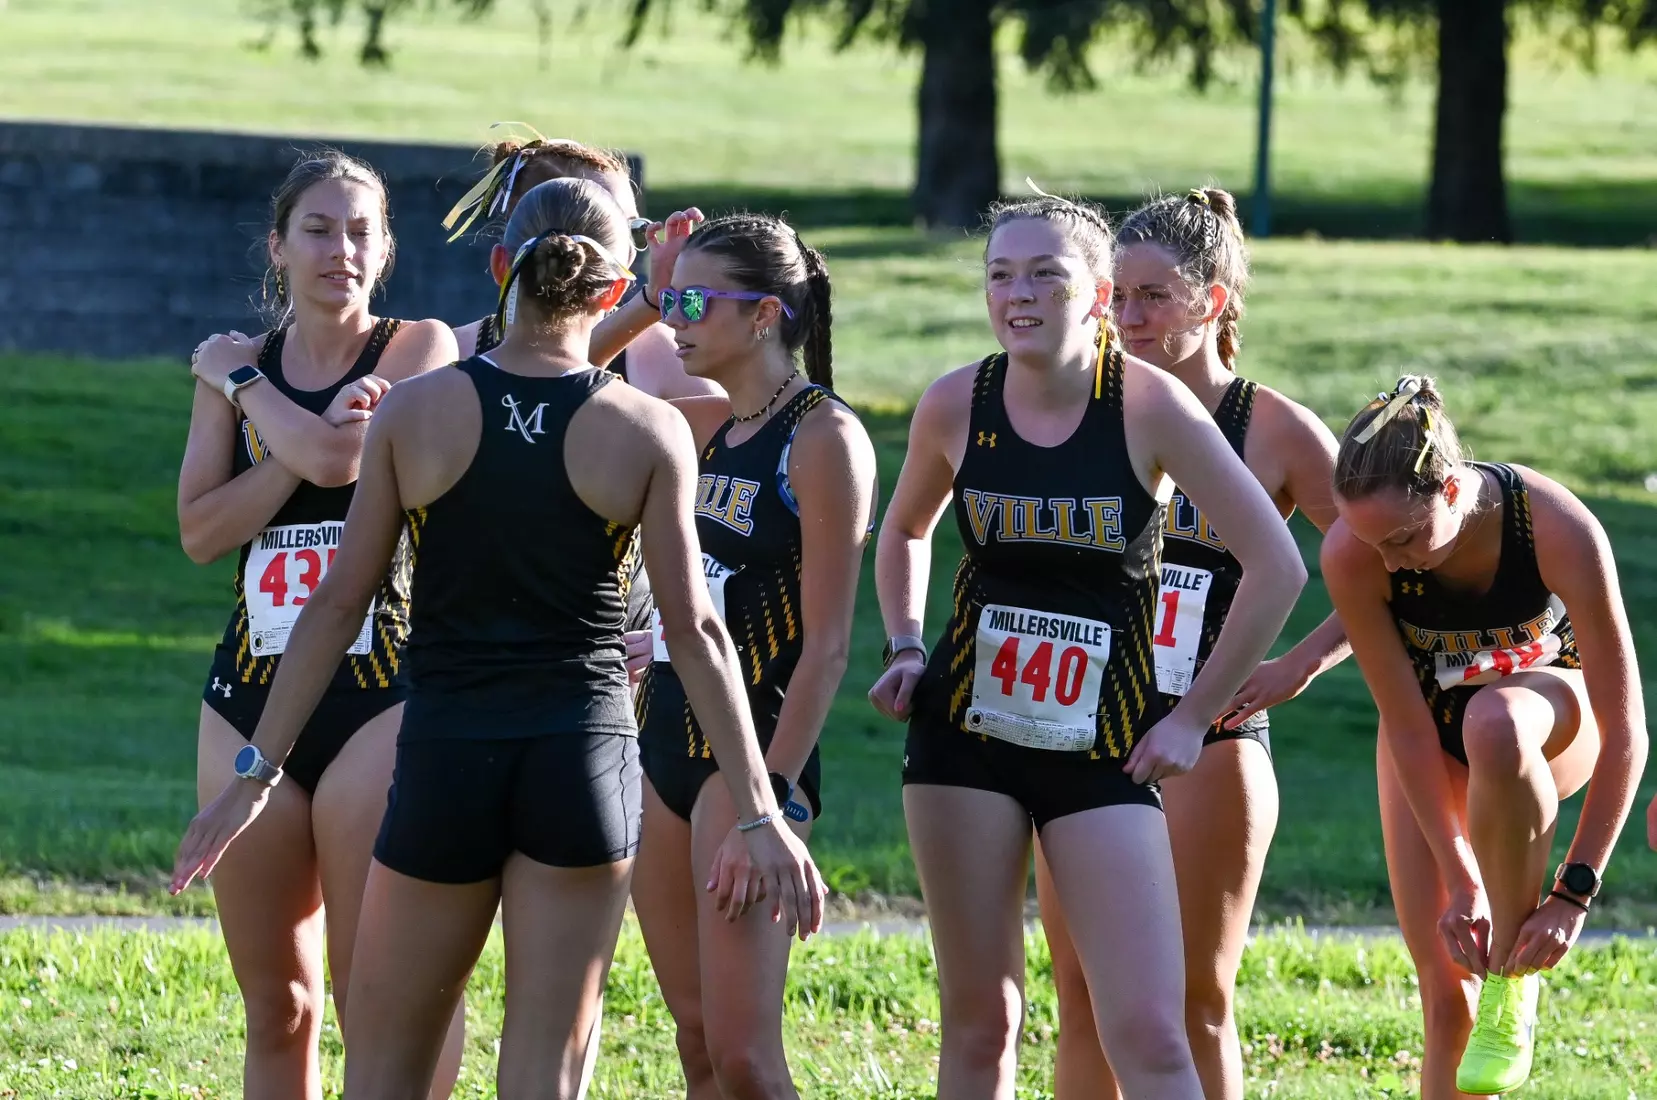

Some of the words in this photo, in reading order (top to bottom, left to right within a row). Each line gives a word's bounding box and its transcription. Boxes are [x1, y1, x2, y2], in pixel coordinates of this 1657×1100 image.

[260, 526, 343, 550] MILLERSVI
[963, 488, 1127, 553] VILLE
[259, 548, 338, 607] 43
[988, 609, 1104, 647] MILLERSVILLE
[990, 636, 1089, 706] 440
